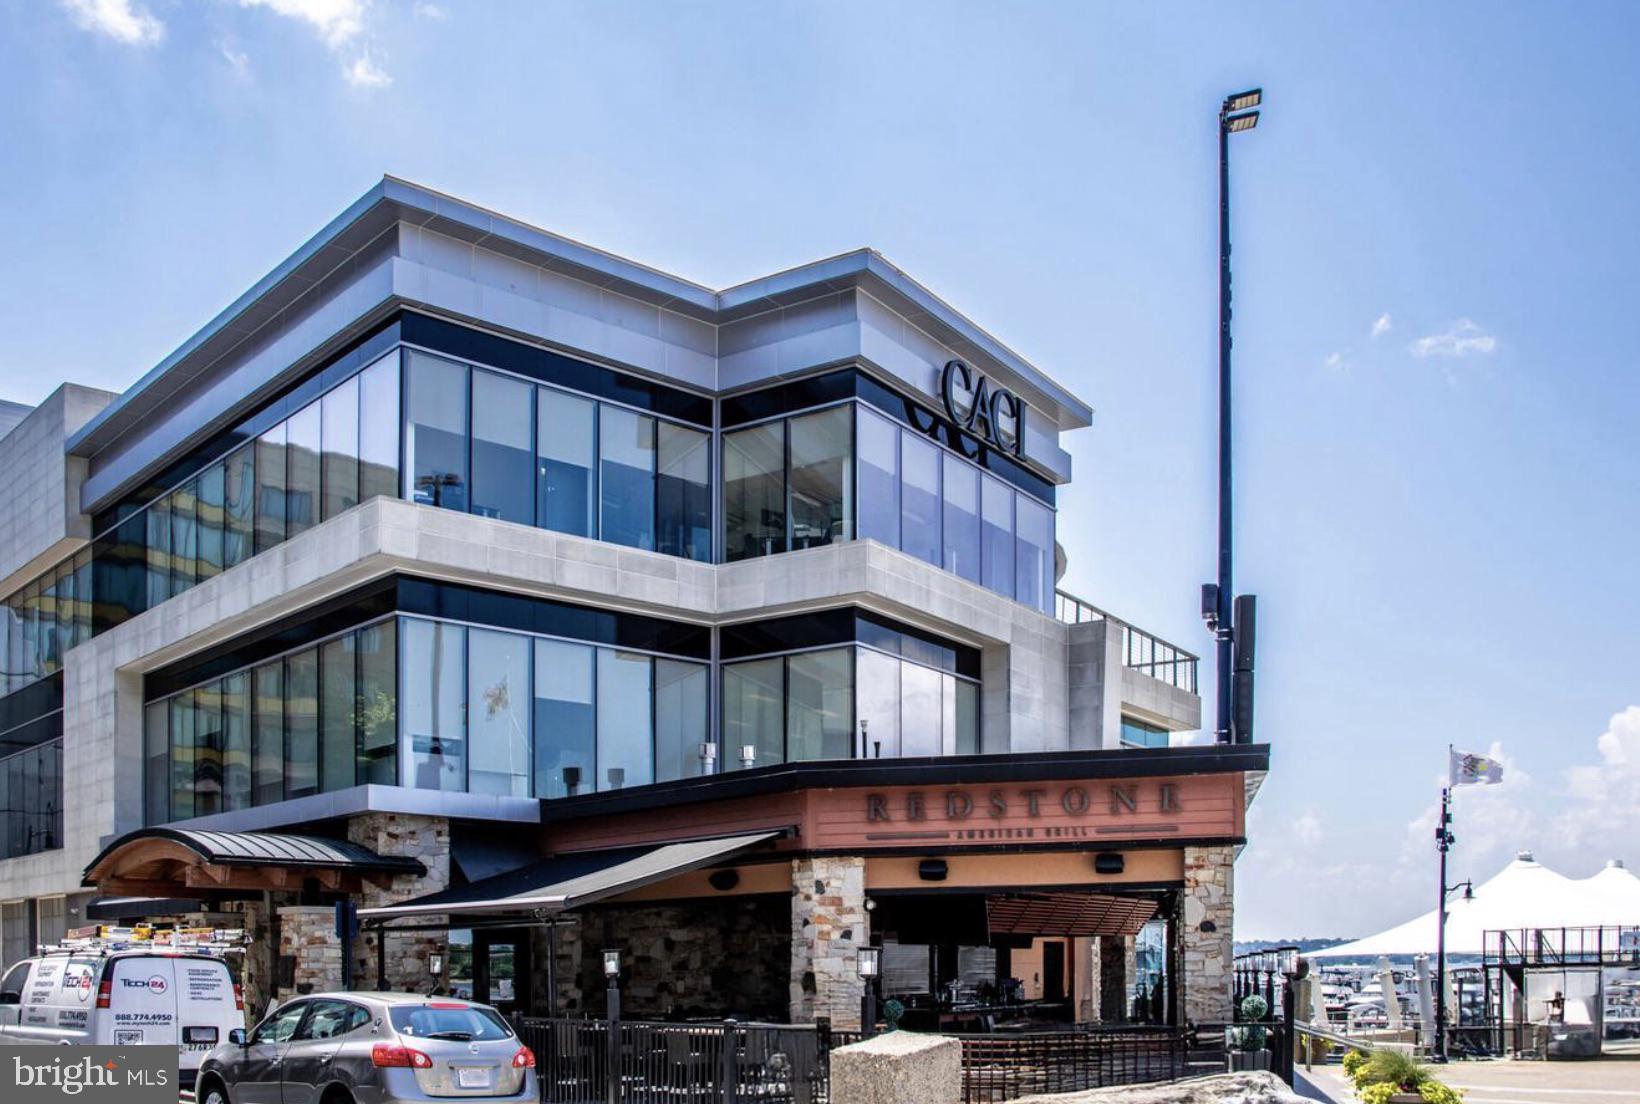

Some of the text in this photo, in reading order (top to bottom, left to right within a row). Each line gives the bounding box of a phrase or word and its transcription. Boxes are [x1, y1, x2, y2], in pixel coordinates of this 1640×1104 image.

[942, 359, 1028, 461] CACI
[866, 783, 1183, 823] REDSTONE
[115, 1013, 173, 1021] 888.774.4950
